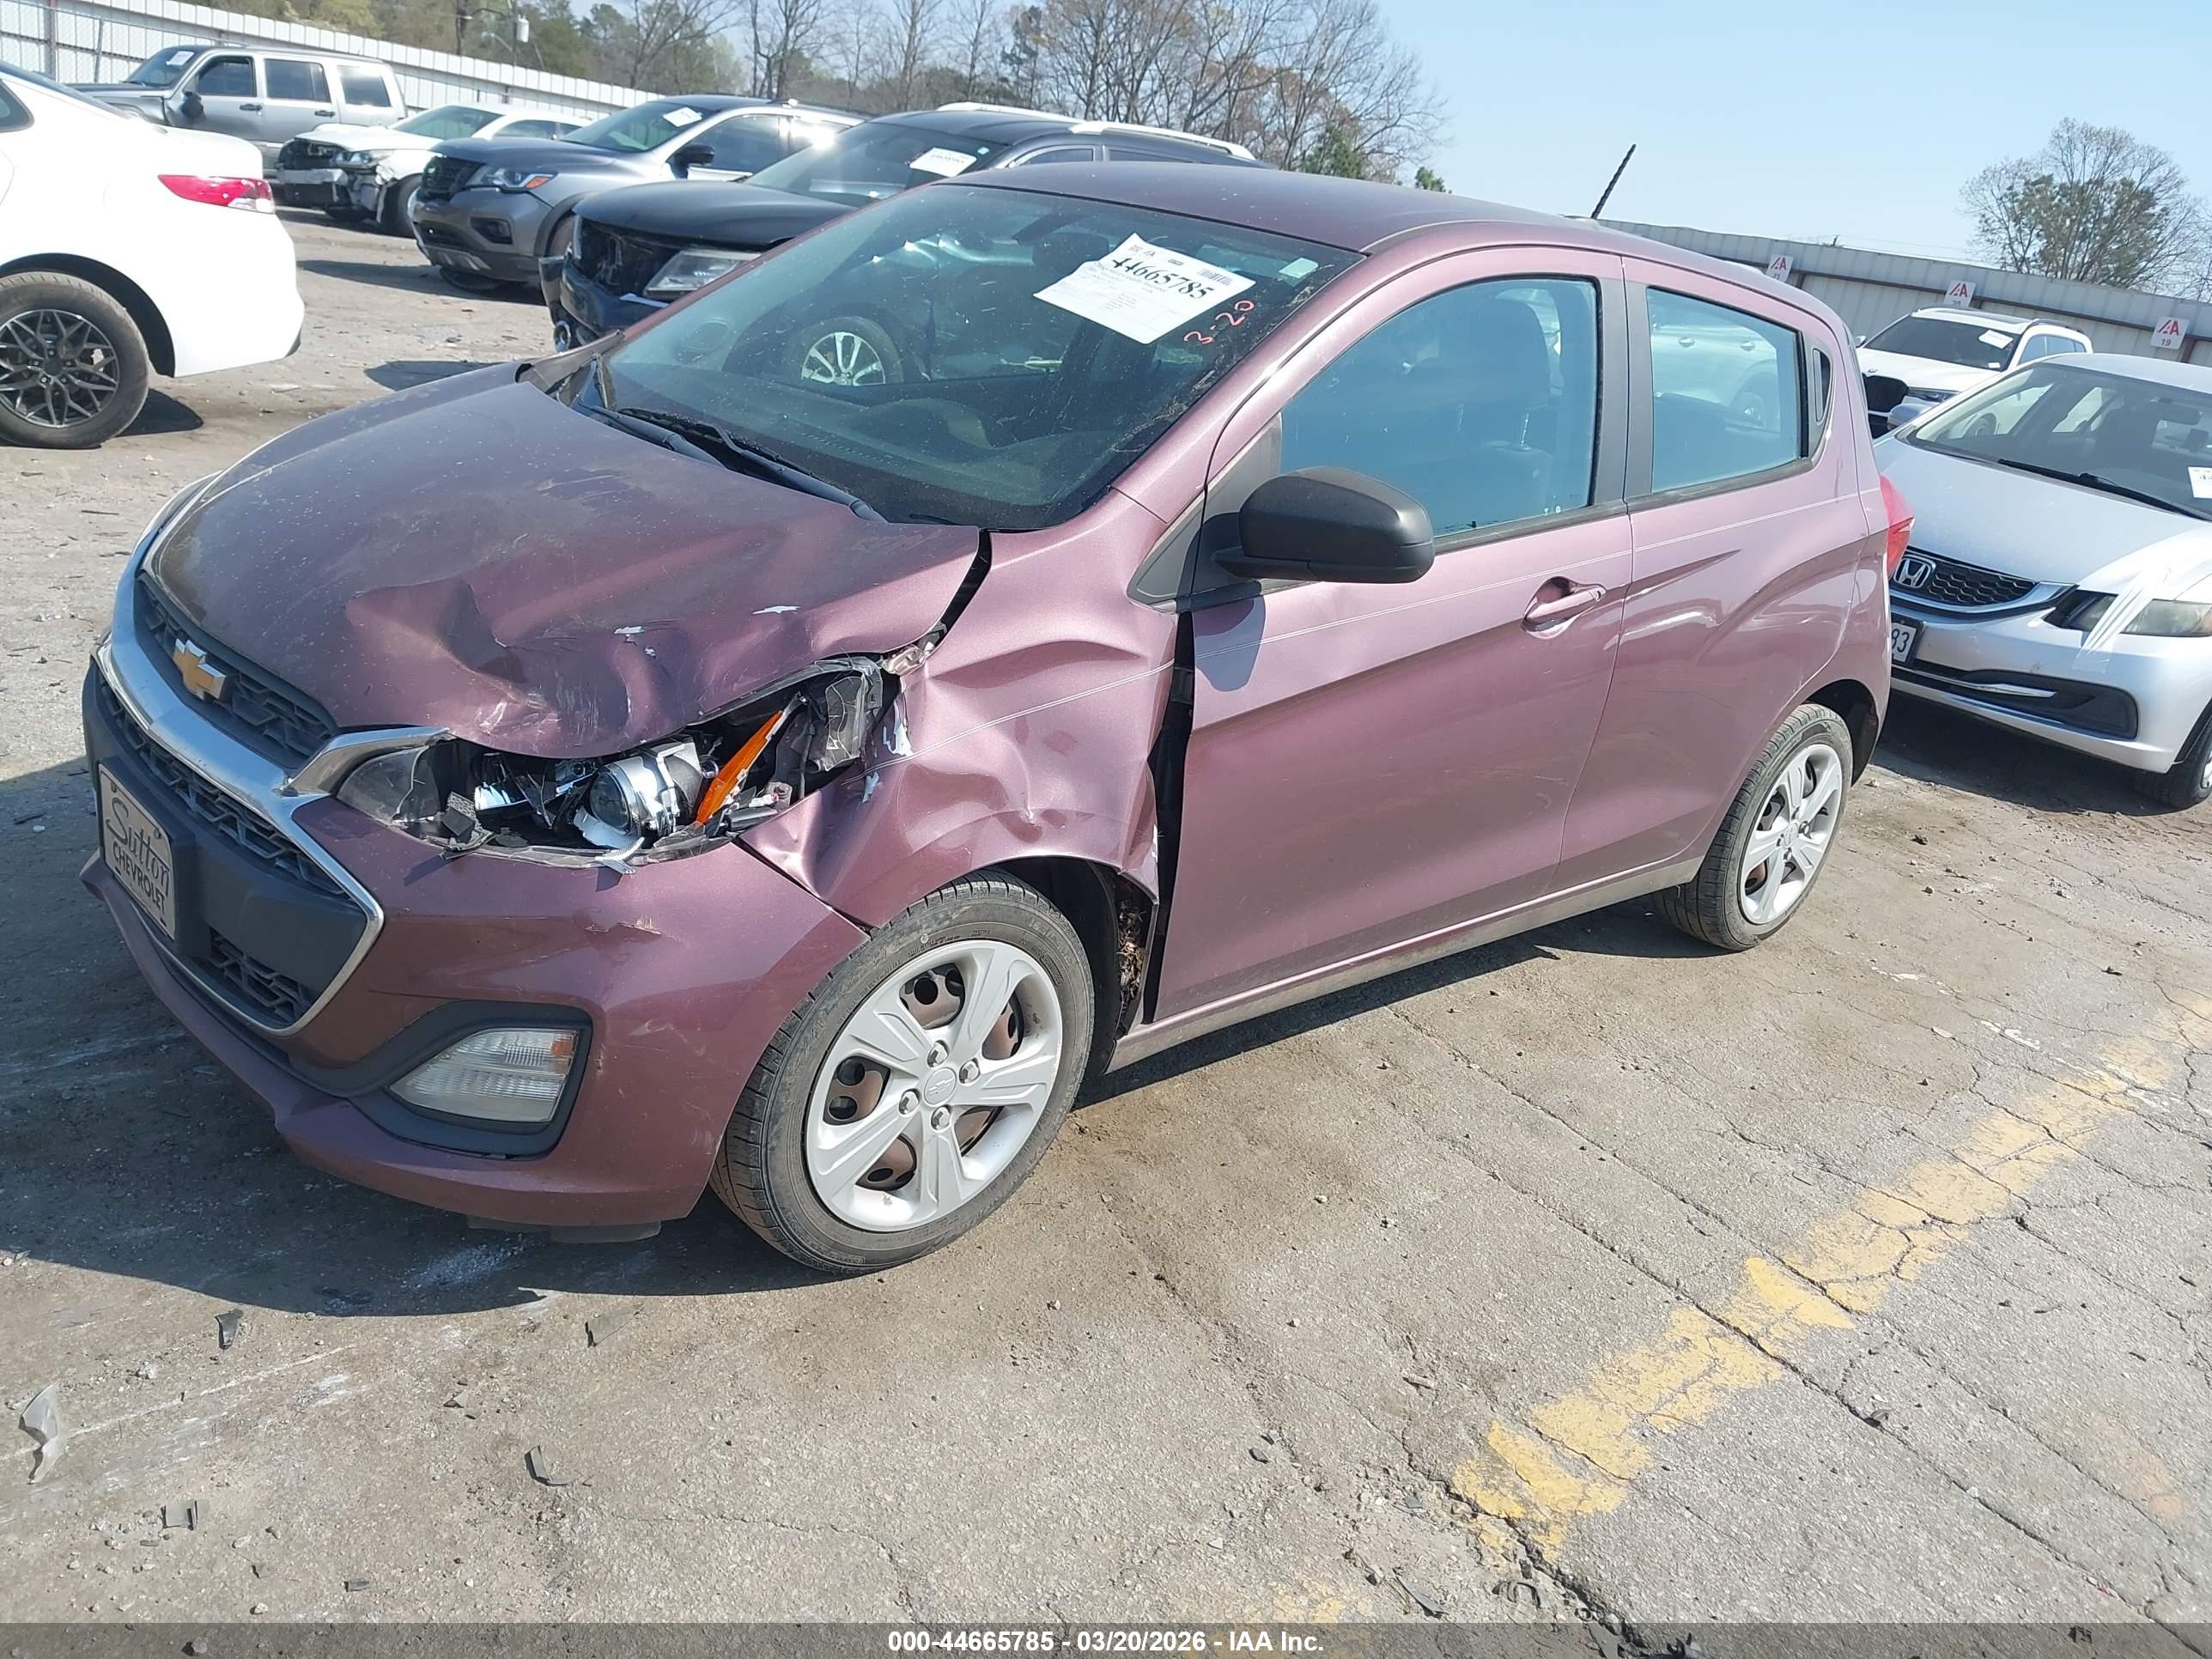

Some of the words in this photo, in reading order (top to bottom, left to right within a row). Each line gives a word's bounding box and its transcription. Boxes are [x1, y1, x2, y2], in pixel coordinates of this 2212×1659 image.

[1112, 257, 1215, 300] 44665785
[2160, 338, 2172, 347] 19
[106, 796, 171, 897] Sutton
[112, 841, 166, 914] CHEVROLET
